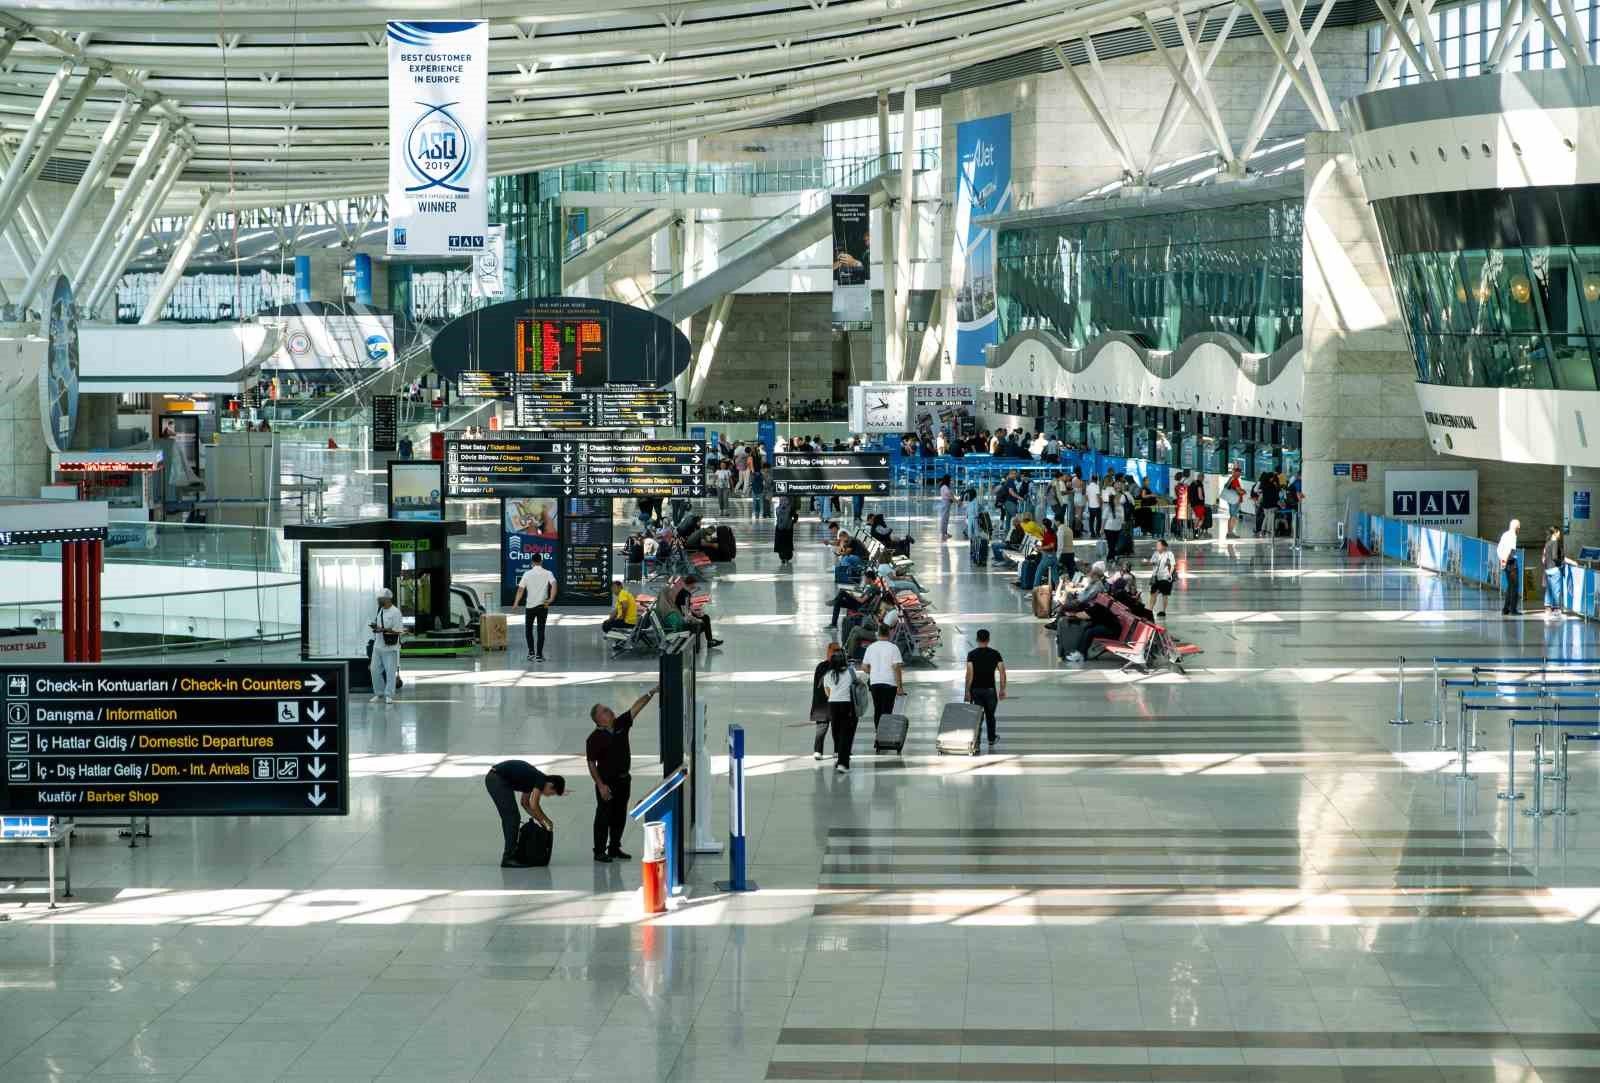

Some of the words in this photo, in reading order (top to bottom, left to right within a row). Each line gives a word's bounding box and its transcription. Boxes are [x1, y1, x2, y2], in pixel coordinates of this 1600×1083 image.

[401, 54, 422, 62] BEST
[425, 54, 472, 62] CUSTOMER
[409, 65, 463, 73] EXPERIENCE
[414, 75, 424, 84] IN
[425, 75, 460, 83] EUROPE
[418, 132, 457, 160] ASQ
[425, 162, 450, 170] 2019
[418, 201, 457, 213] WINNER
[1397, 494, 1466, 512] TAV
[25, 642, 48, 650] SALES
[36, 678, 94, 692] Check-in
[97, 678, 169, 692] Kontuarları
[180, 678, 239, 691] Check-in
[242, 678, 302, 690] Counters
[36, 708, 94, 722] Danışma
[106, 708, 178, 720] Information
[36, 734, 48, 752] İç
[52, 736, 91, 749] Hatlar
[94, 736, 128, 752] Gidiş
[139, 736, 199, 748] Domestic
[202, 735, 274, 750] Departures
[36, 762, 48, 780] İç
[58, 764, 76, 780] Dış
[78, 764, 112, 776] Hatlar
[114, 764, 142, 779] Geliş
[152, 763, 180, 776] Dom.
[190, 763, 207, 776] Int.
[210, 762, 250, 776] Arrivals
[38, 791, 76, 803] Kuaför
[87, 791, 125, 802] Barber
[128, 790, 159, 804] Shop
